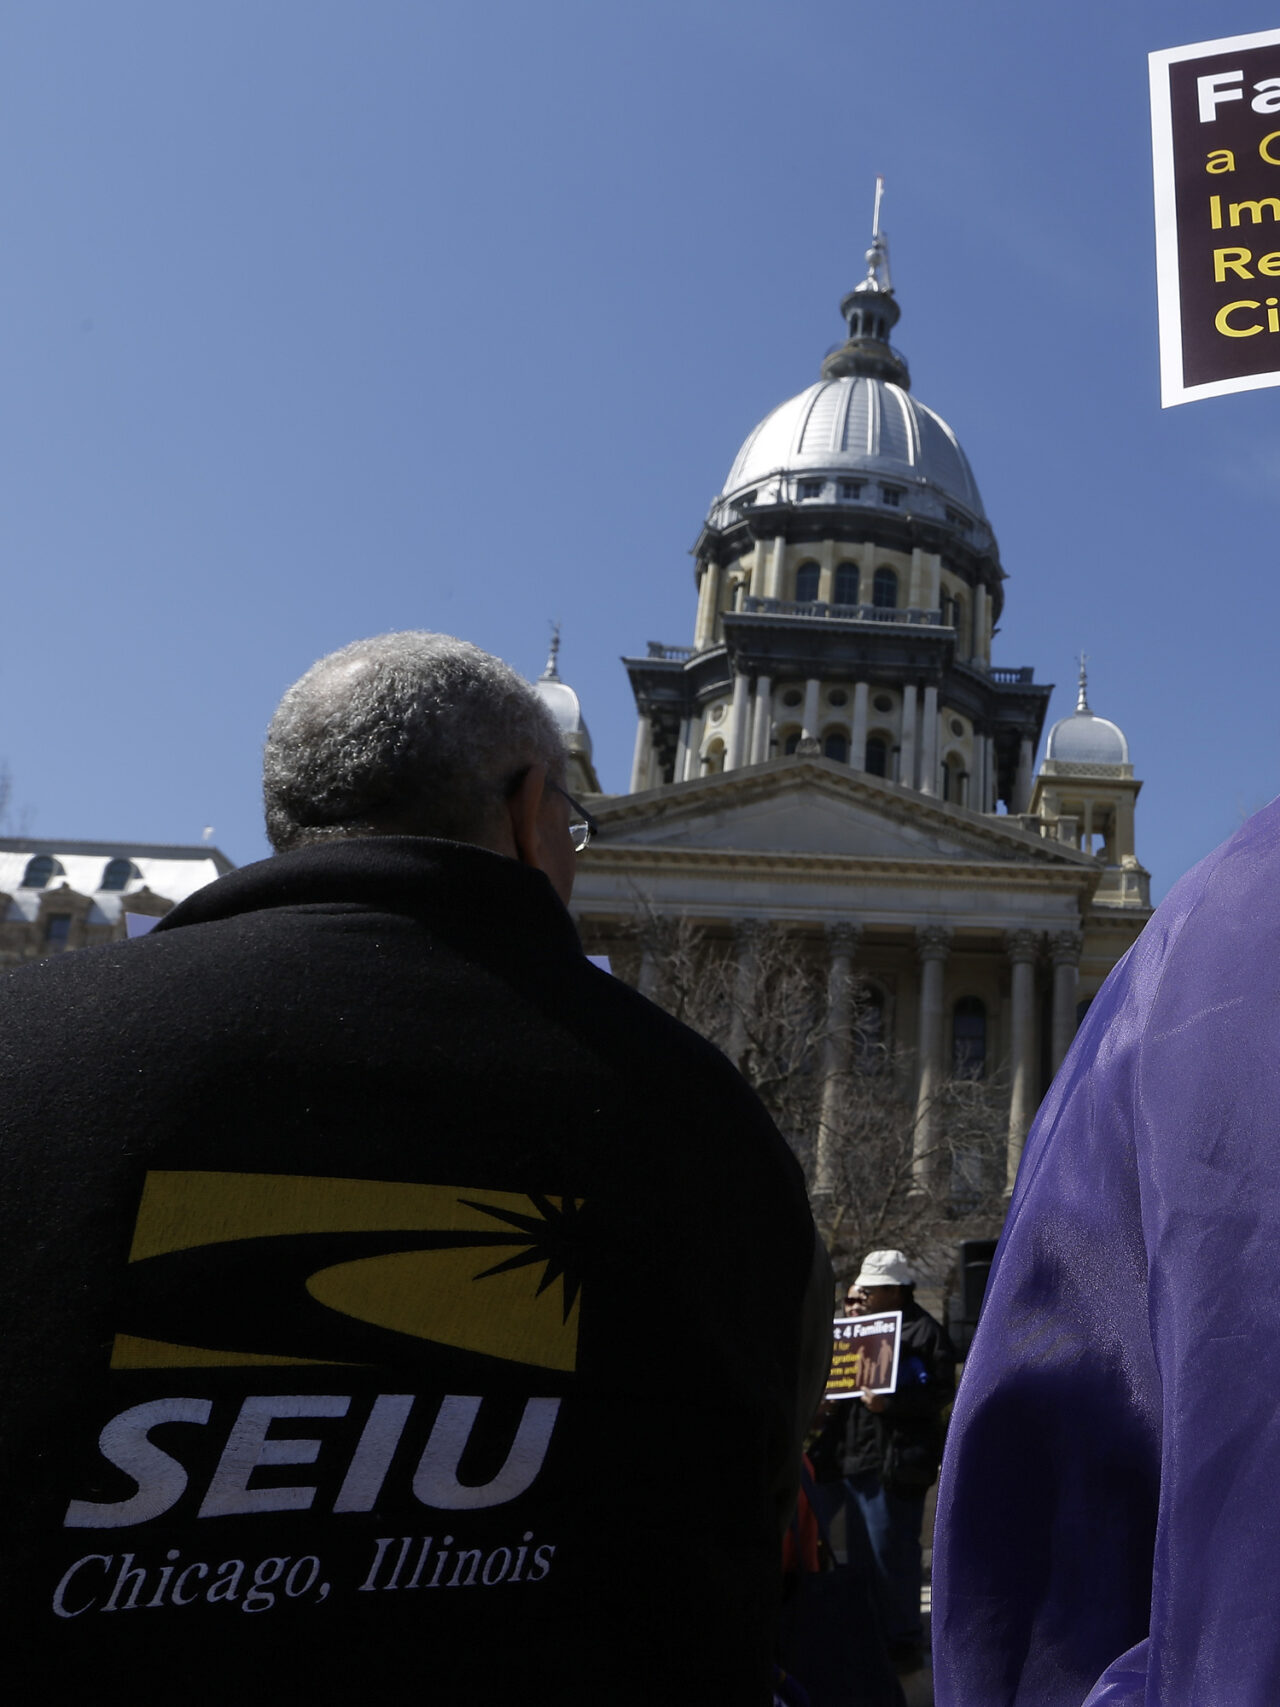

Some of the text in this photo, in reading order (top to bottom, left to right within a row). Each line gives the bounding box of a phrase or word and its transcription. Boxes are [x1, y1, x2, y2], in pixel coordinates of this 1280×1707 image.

[1205, 149, 1236, 175] a
[842, 1325, 852, 1338] 4
[853, 1320, 895, 1338] Families
[63, 1394, 562, 1529] SEIU
[51, 1531, 556, 1619] Chicago, Illinois
